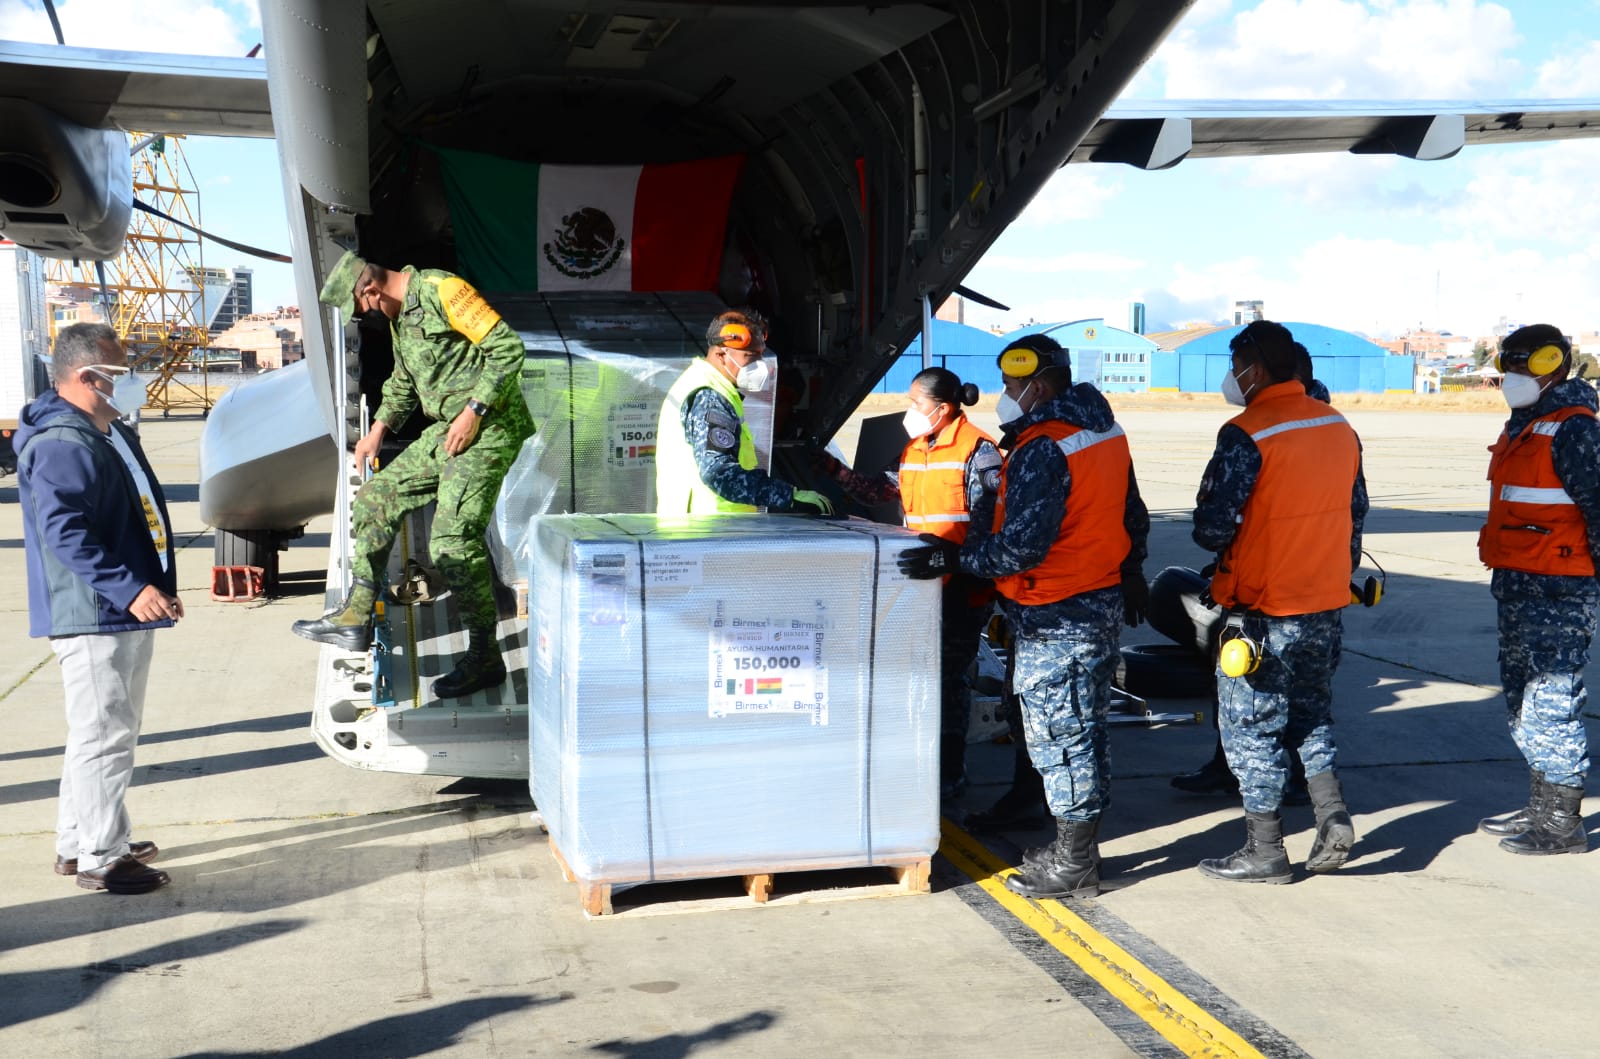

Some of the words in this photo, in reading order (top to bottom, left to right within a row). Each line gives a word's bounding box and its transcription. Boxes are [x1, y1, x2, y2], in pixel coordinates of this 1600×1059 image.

[732, 618, 767, 628] Birmex
[734, 656, 801, 672] 150,000
[735, 701, 769, 710] Birmex
